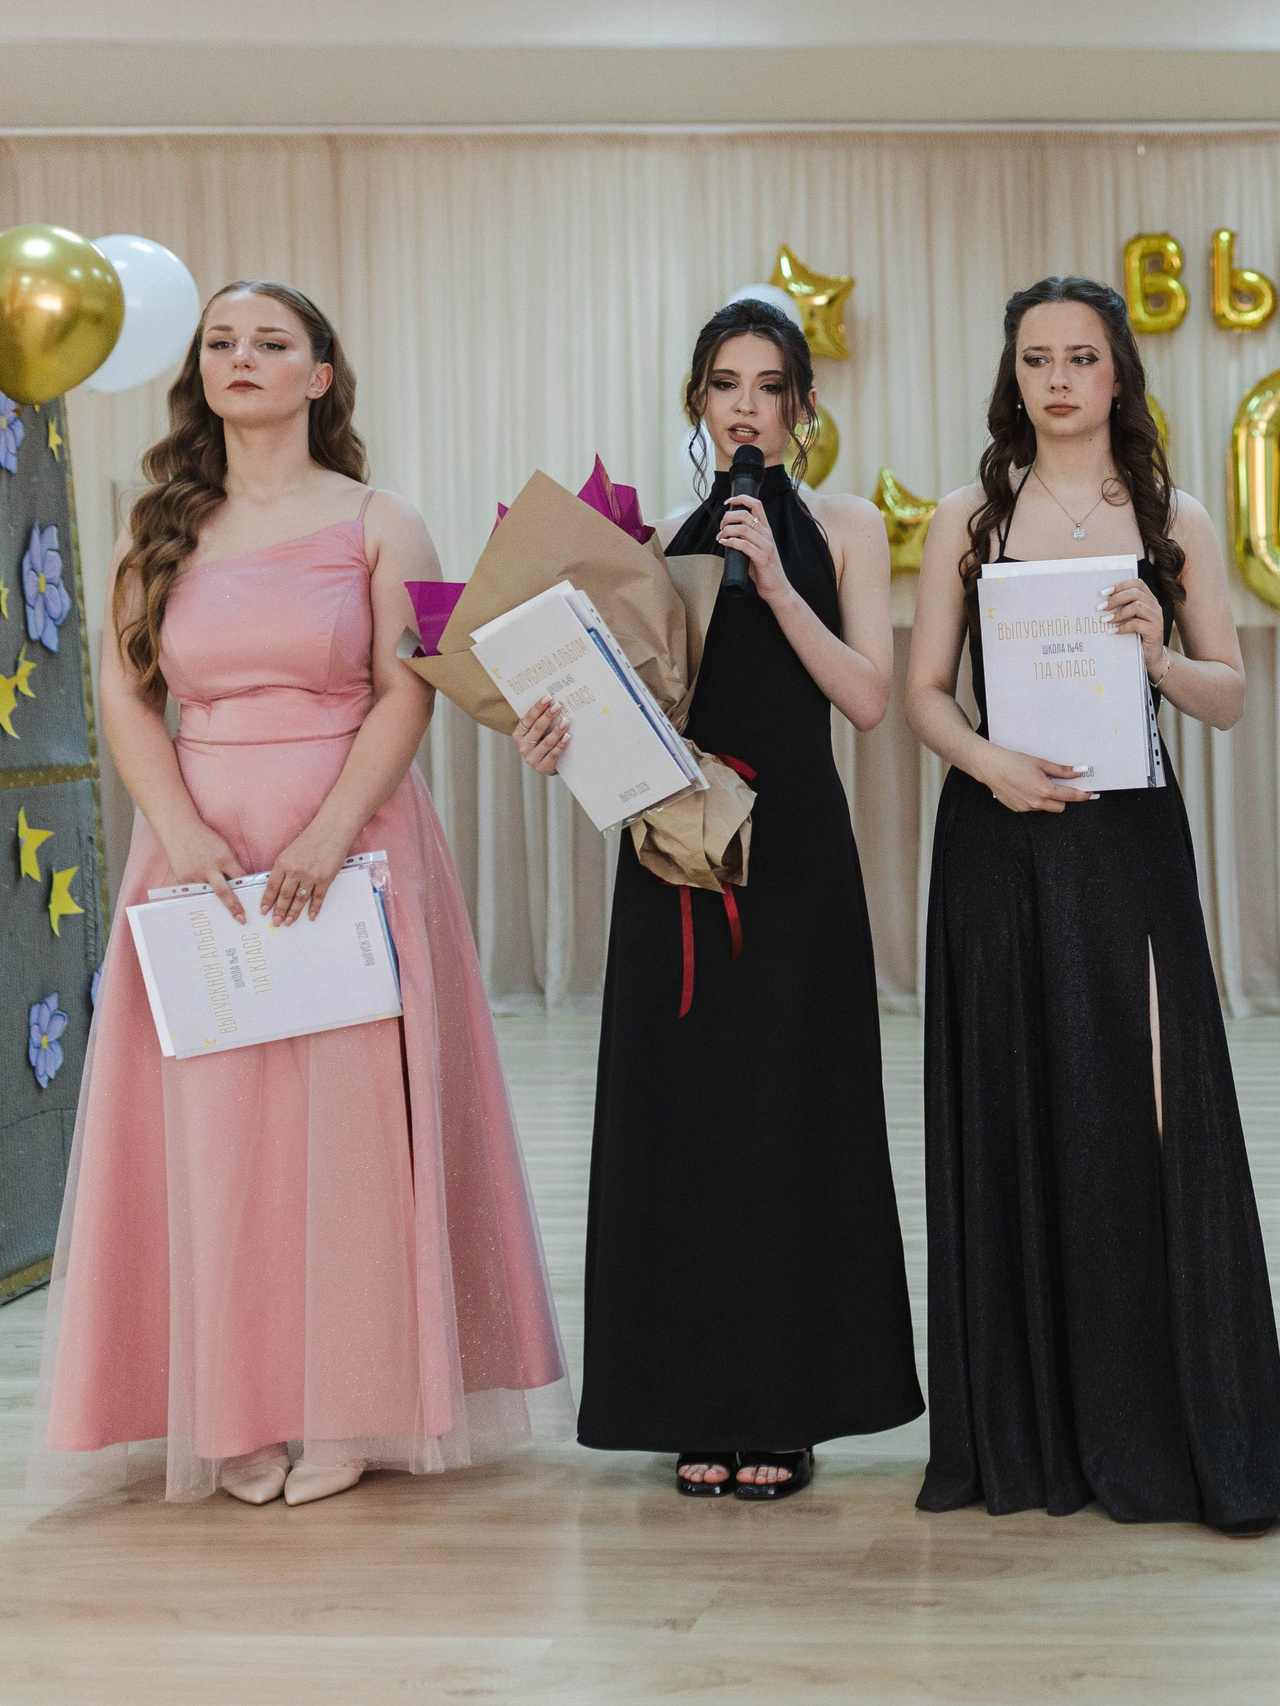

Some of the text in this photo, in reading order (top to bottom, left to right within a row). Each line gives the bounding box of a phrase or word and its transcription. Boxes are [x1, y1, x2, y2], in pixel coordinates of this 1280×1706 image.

[997, 616, 1126, 640] ВЫПУСКНОЙ АЛЬБ
[1042, 642, 1084, 654] ШКОЛА №46
[507, 637, 589, 695] ВЫПУСКНОЙ АЛЬБОМ
[1033, 659, 1096, 680] 11А КЛАСС
[565, 685, 595, 712] КЛАСС
[189, 909, 237, 1035] ВЫПУСКНОЙ АЛЬБОМ
[241, 933, 273, 995] 11А КЛАСС
[230, 965, 245, 989] ШКОЛА
